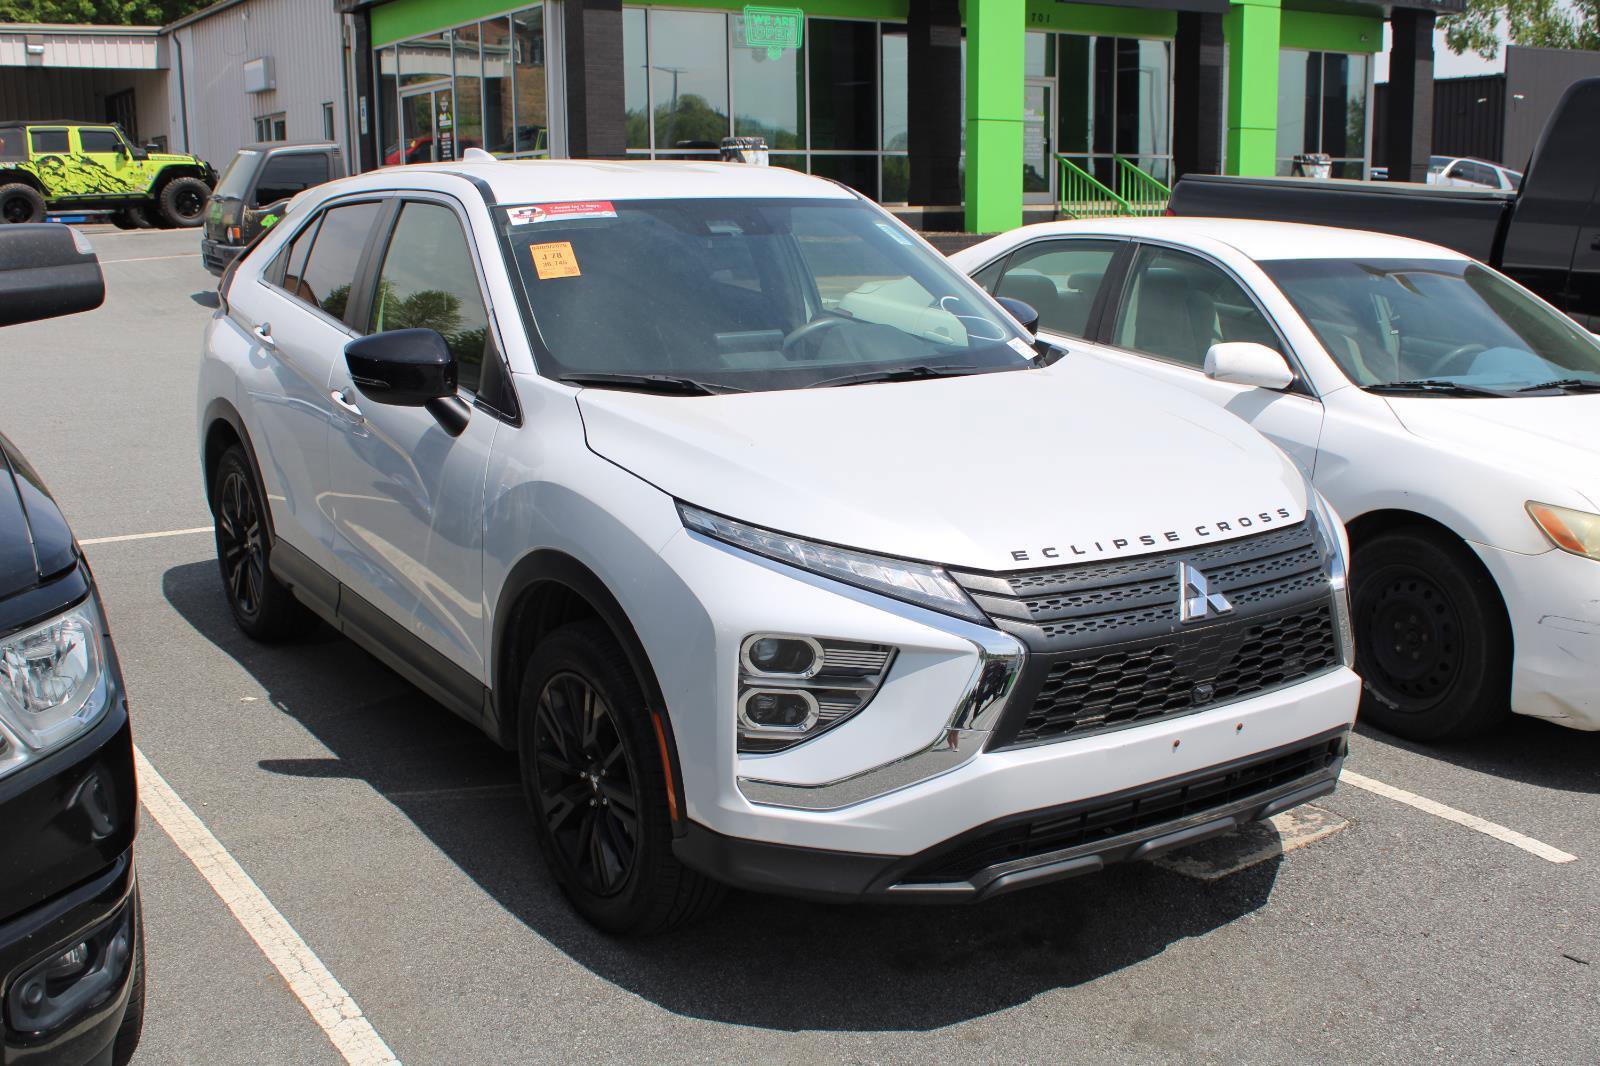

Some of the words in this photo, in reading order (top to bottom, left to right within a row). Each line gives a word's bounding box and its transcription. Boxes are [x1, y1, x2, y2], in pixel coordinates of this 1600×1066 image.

[752, 14, 771, 25] WE
[774, 15, 795, 27] ARE
[1031, 12, 1051, 24] 701
[752, 25, 796, 41] OPEN
[1011, 531, 1180, 561] ECLIPSE
[1195, 508, 1290, 536] CROSS
